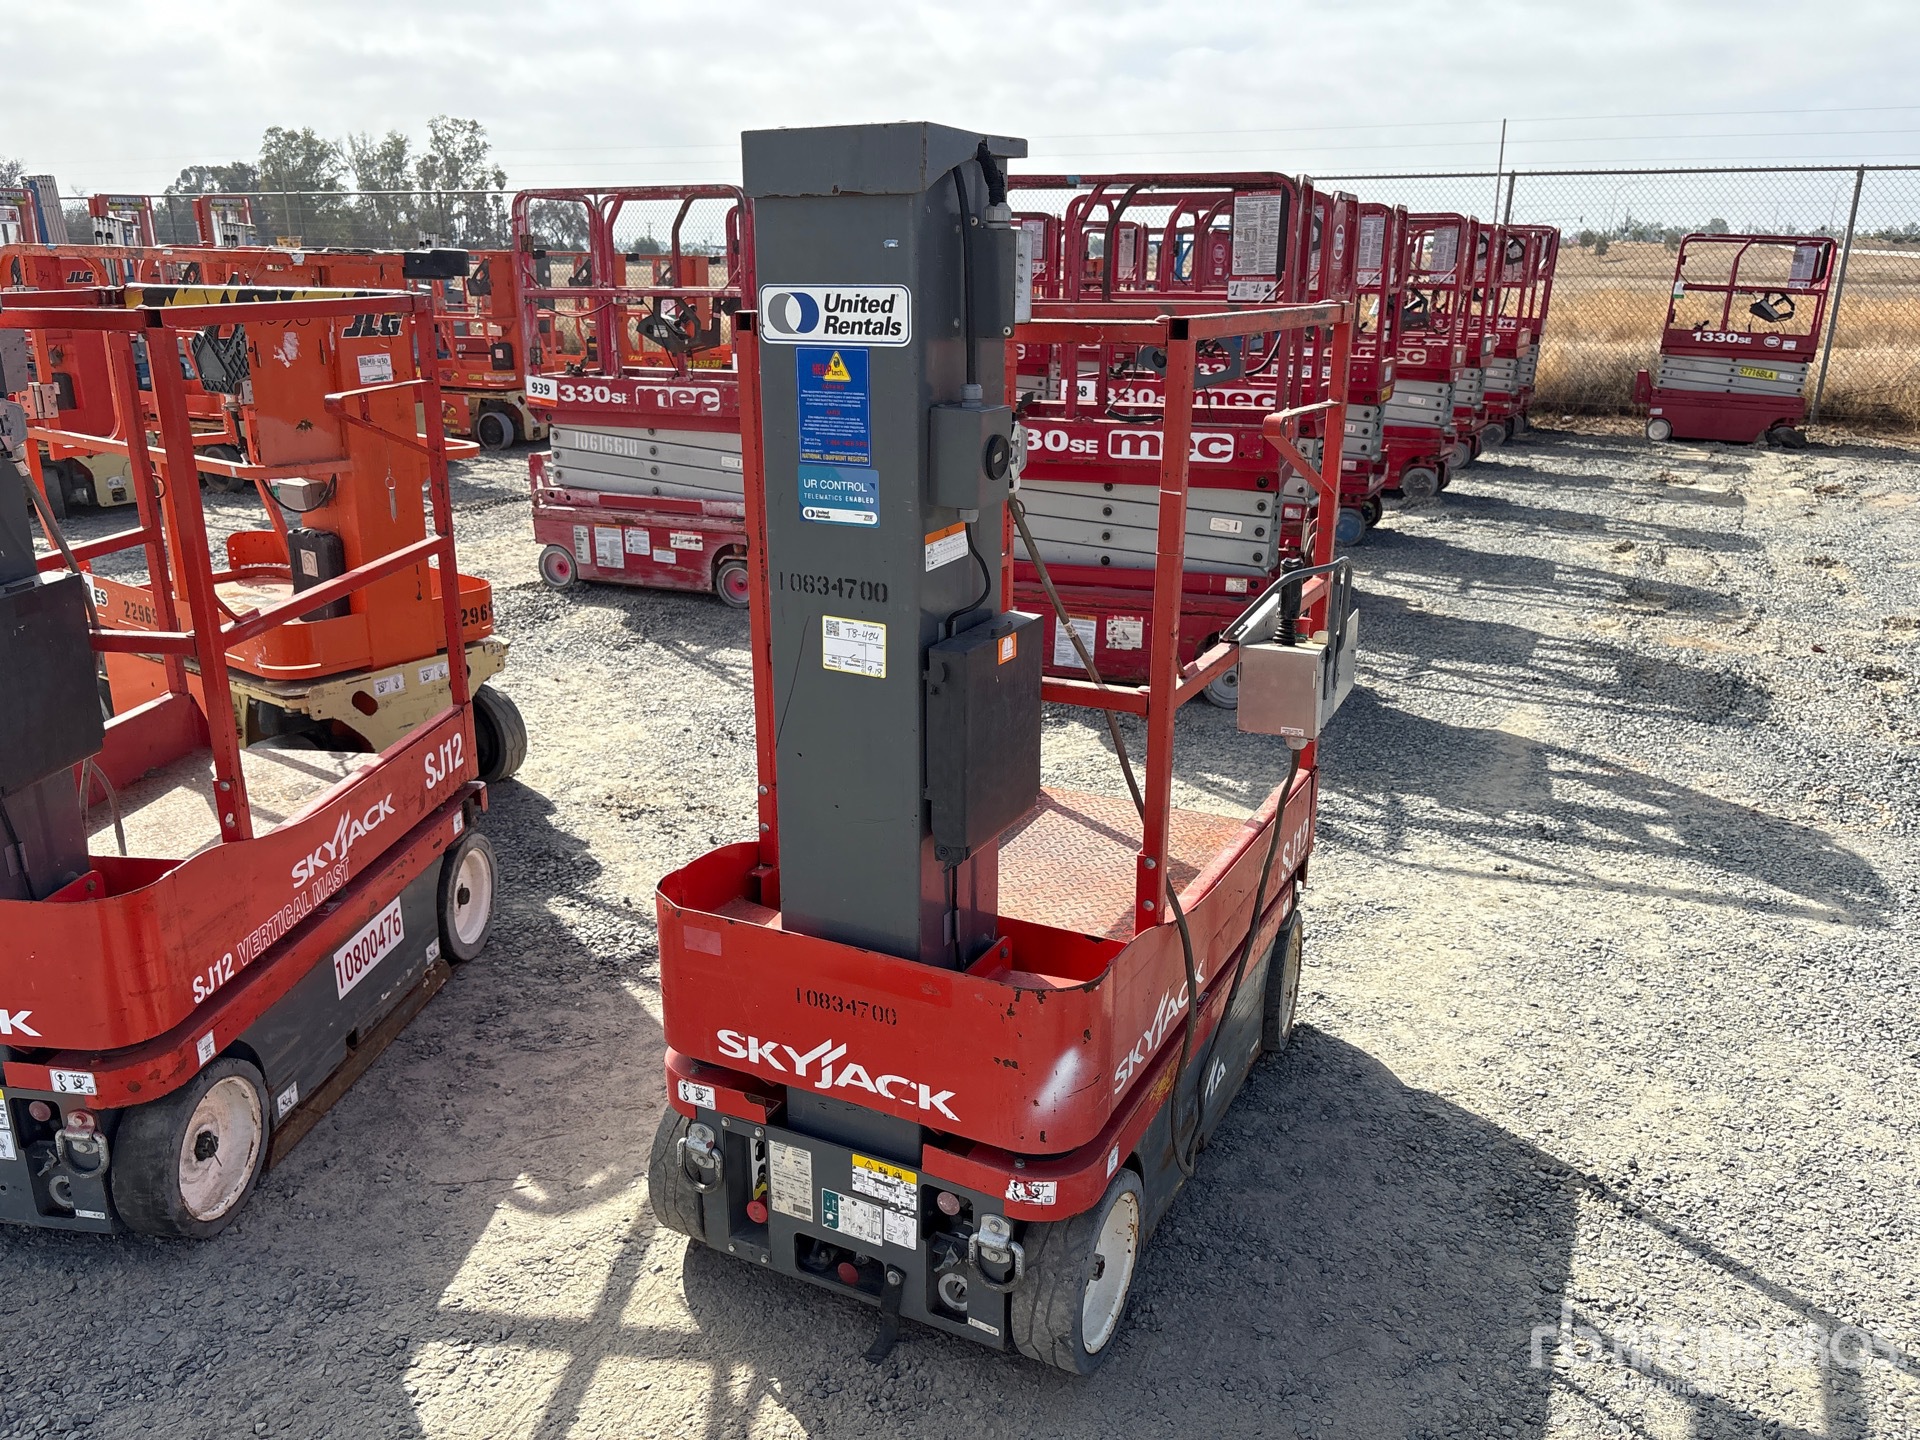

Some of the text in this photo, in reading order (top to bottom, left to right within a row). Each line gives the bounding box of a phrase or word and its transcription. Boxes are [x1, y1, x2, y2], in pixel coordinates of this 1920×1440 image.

[66, 271, 94, 283] JLG
[823, 293, 896, 313] United
[341, 314, 403, 338] JLG
[823, 315, 902, 336] Rentals
[1692, 331, 1752, 344] 1330SE
[531, 382, 551, 396] 939
[558, 384, 628, 405] 330SE
[1192, 390, 1276, 407] mec
[574, 431, 638, 457] 10616610
[1027, 429, 1231, 460] 30SE mc
[803, 478, 868, 492] UR CONTROL
[803, 493, 875, 504] TELEMATICS ENABLED
[779, 571, 888, 603] 10834700
[845, 627, 880, 641] T8-424
[424, 732, 465, 790] SJ12
[291, 792, 396, 889] SKYJACK
[191, 856, 350, 1004] SJ12 VERTICAL MAST
[335, 906, 401, 990] 10800476
[795, 986, 898, 1027] 10834700
[716, 1028, 962, 1123] SKYJACK
